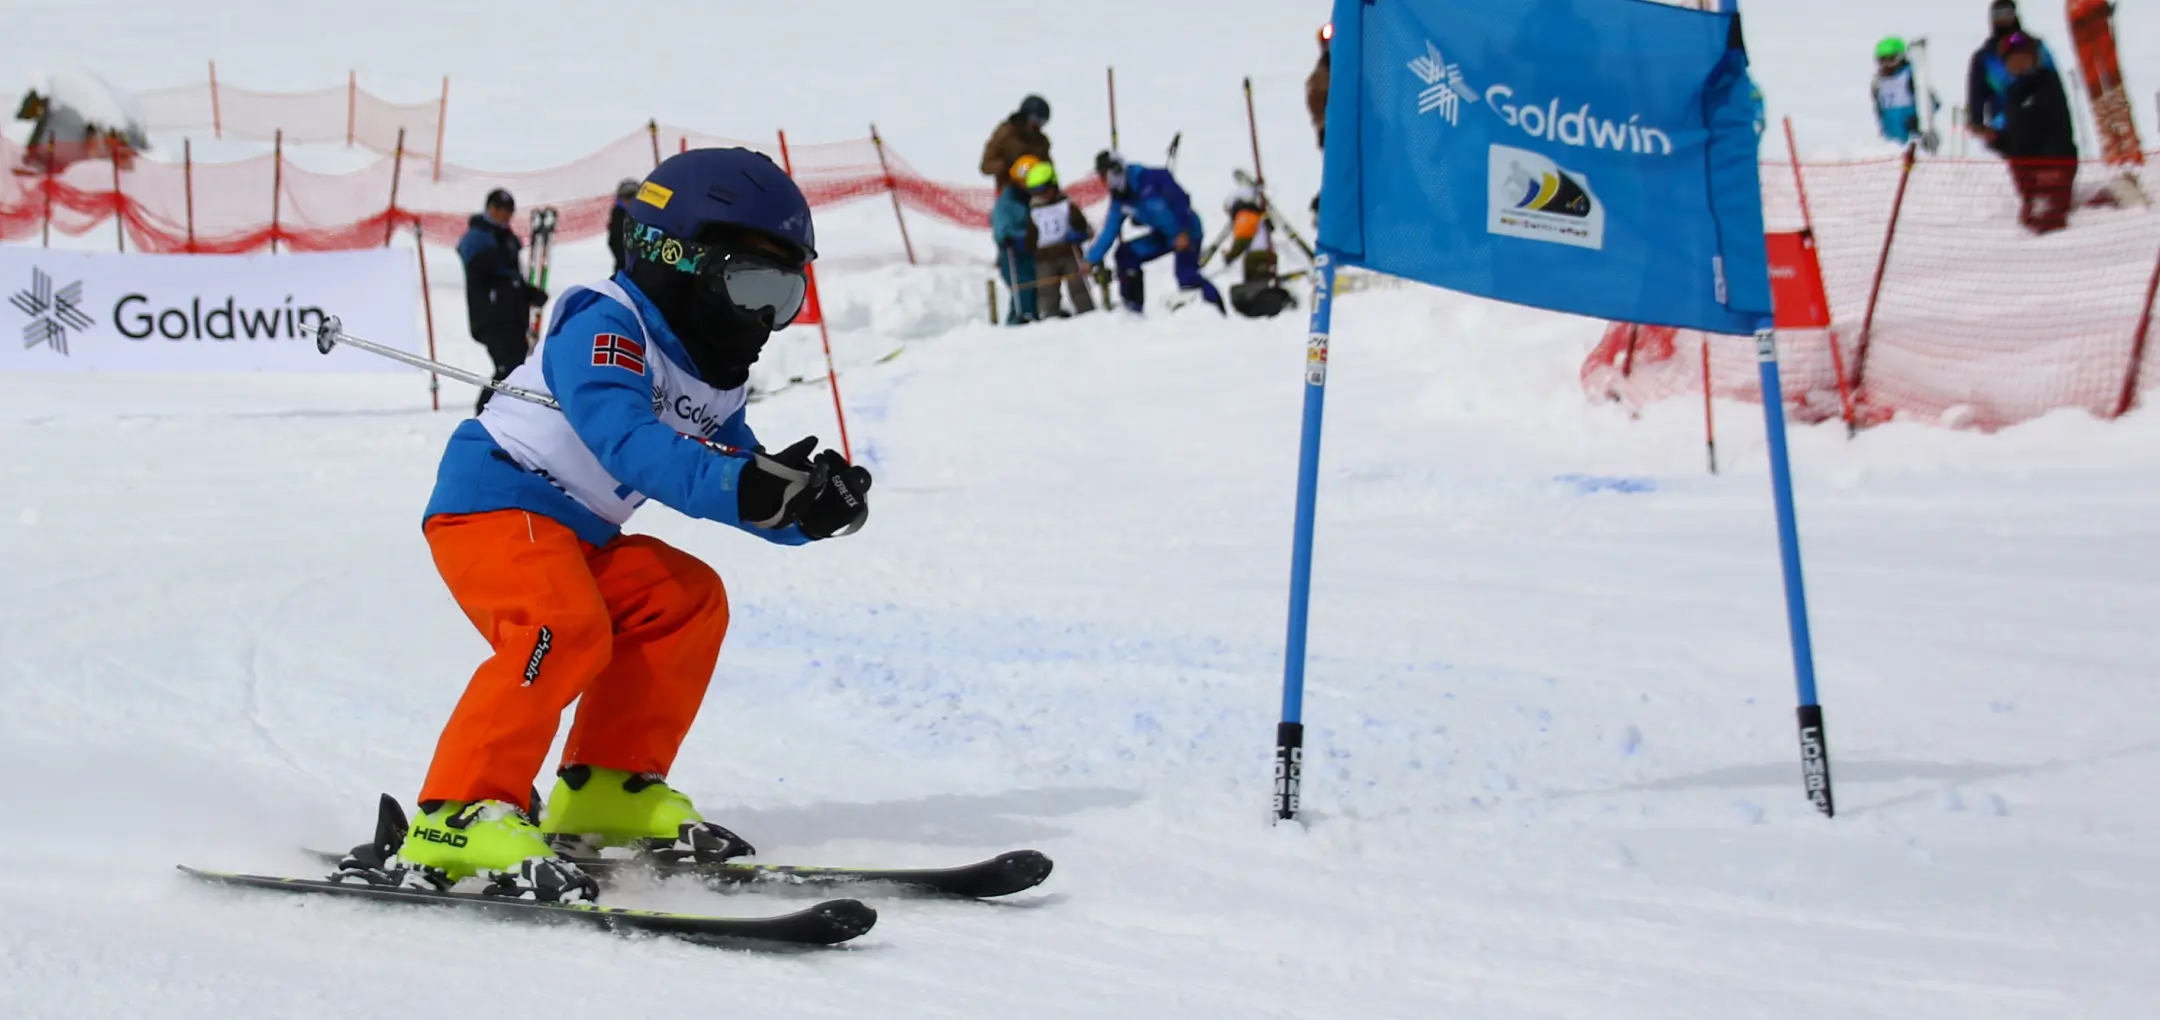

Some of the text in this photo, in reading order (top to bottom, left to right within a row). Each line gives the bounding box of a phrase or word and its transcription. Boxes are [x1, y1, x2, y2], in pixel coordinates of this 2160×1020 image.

[1485, 84, 1673, 156] Goldwin
[831, 474, 860, 509] GORE-TEX
[525, 626, 551, 680] phenix
[413, 825, 469, 848] HEAD
